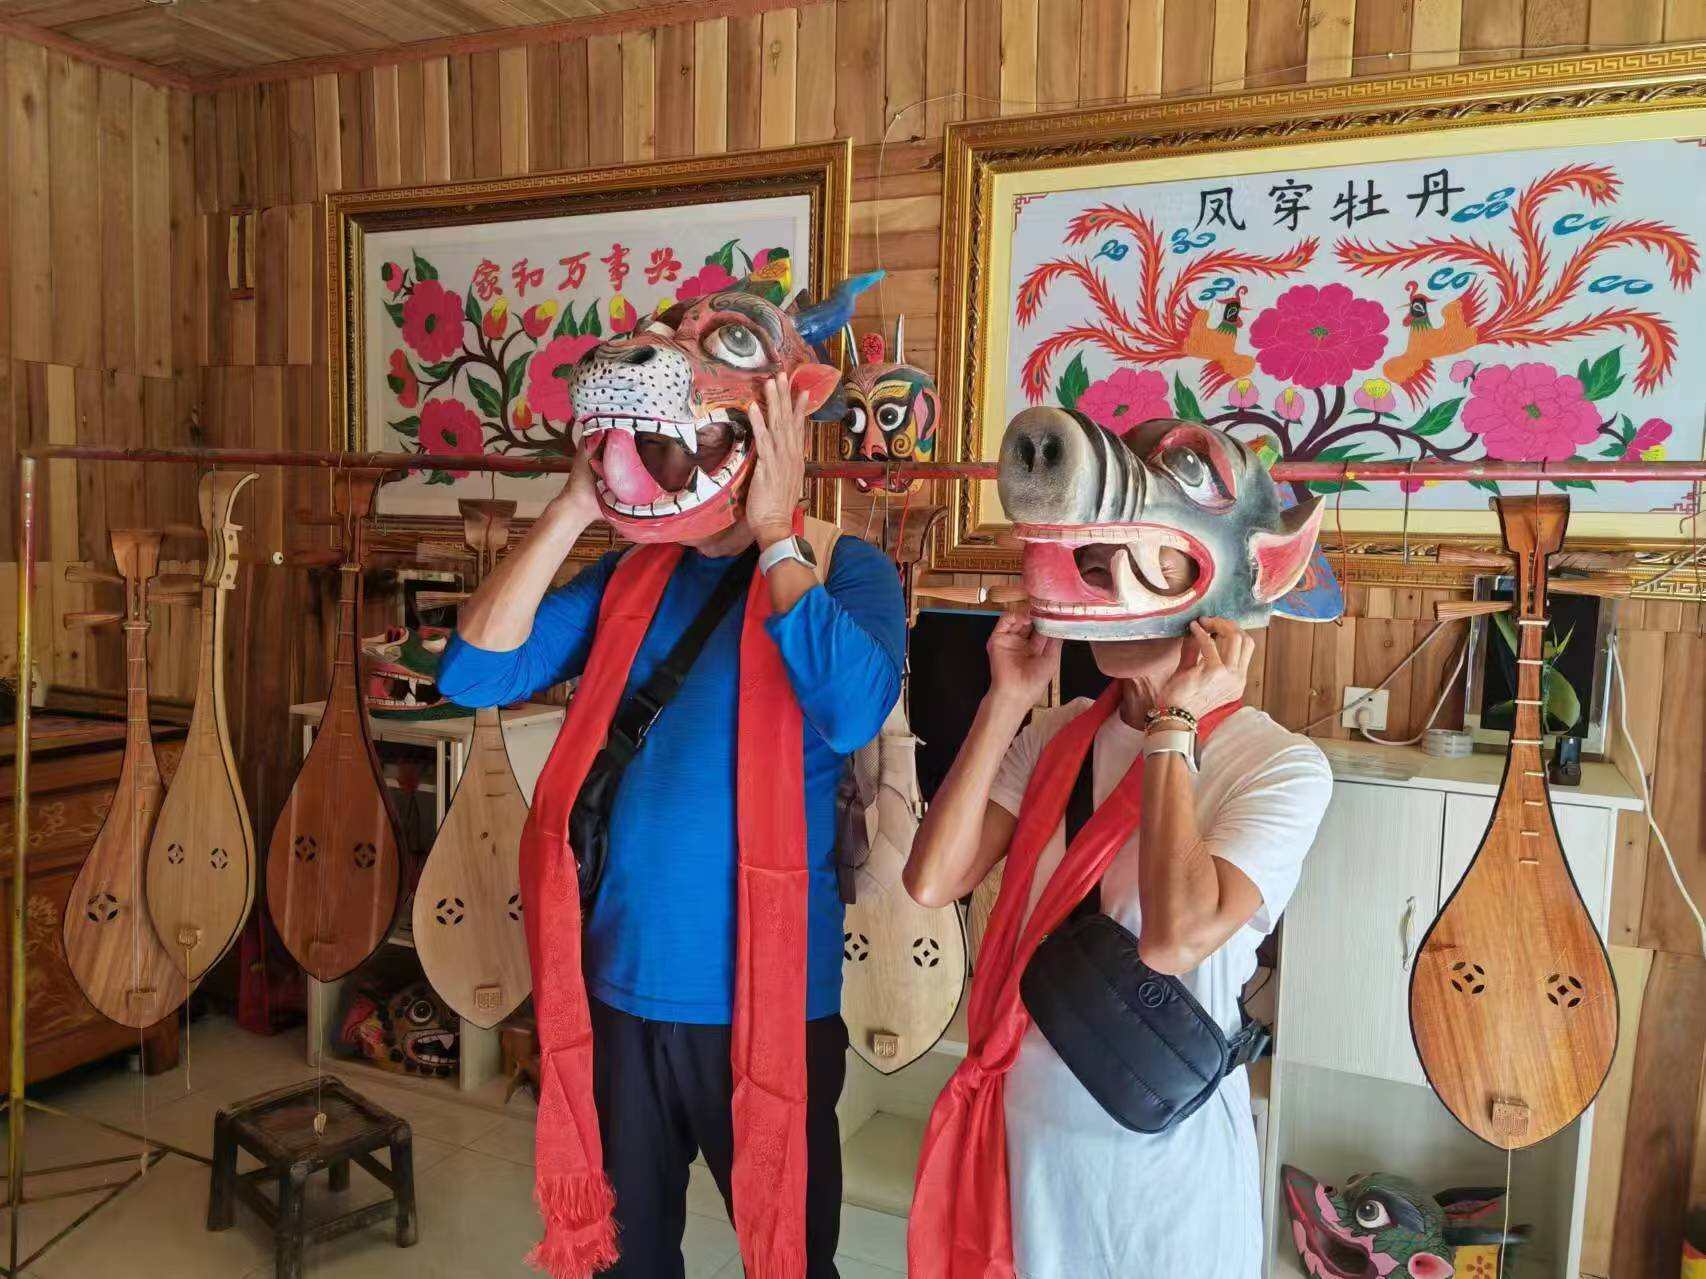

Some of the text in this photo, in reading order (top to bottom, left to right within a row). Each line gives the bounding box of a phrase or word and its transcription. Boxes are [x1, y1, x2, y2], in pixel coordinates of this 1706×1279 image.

[1194, 168, 1465, 231] 凤穿牡丹
[472, 243, 682, 300] 家和万事兴
